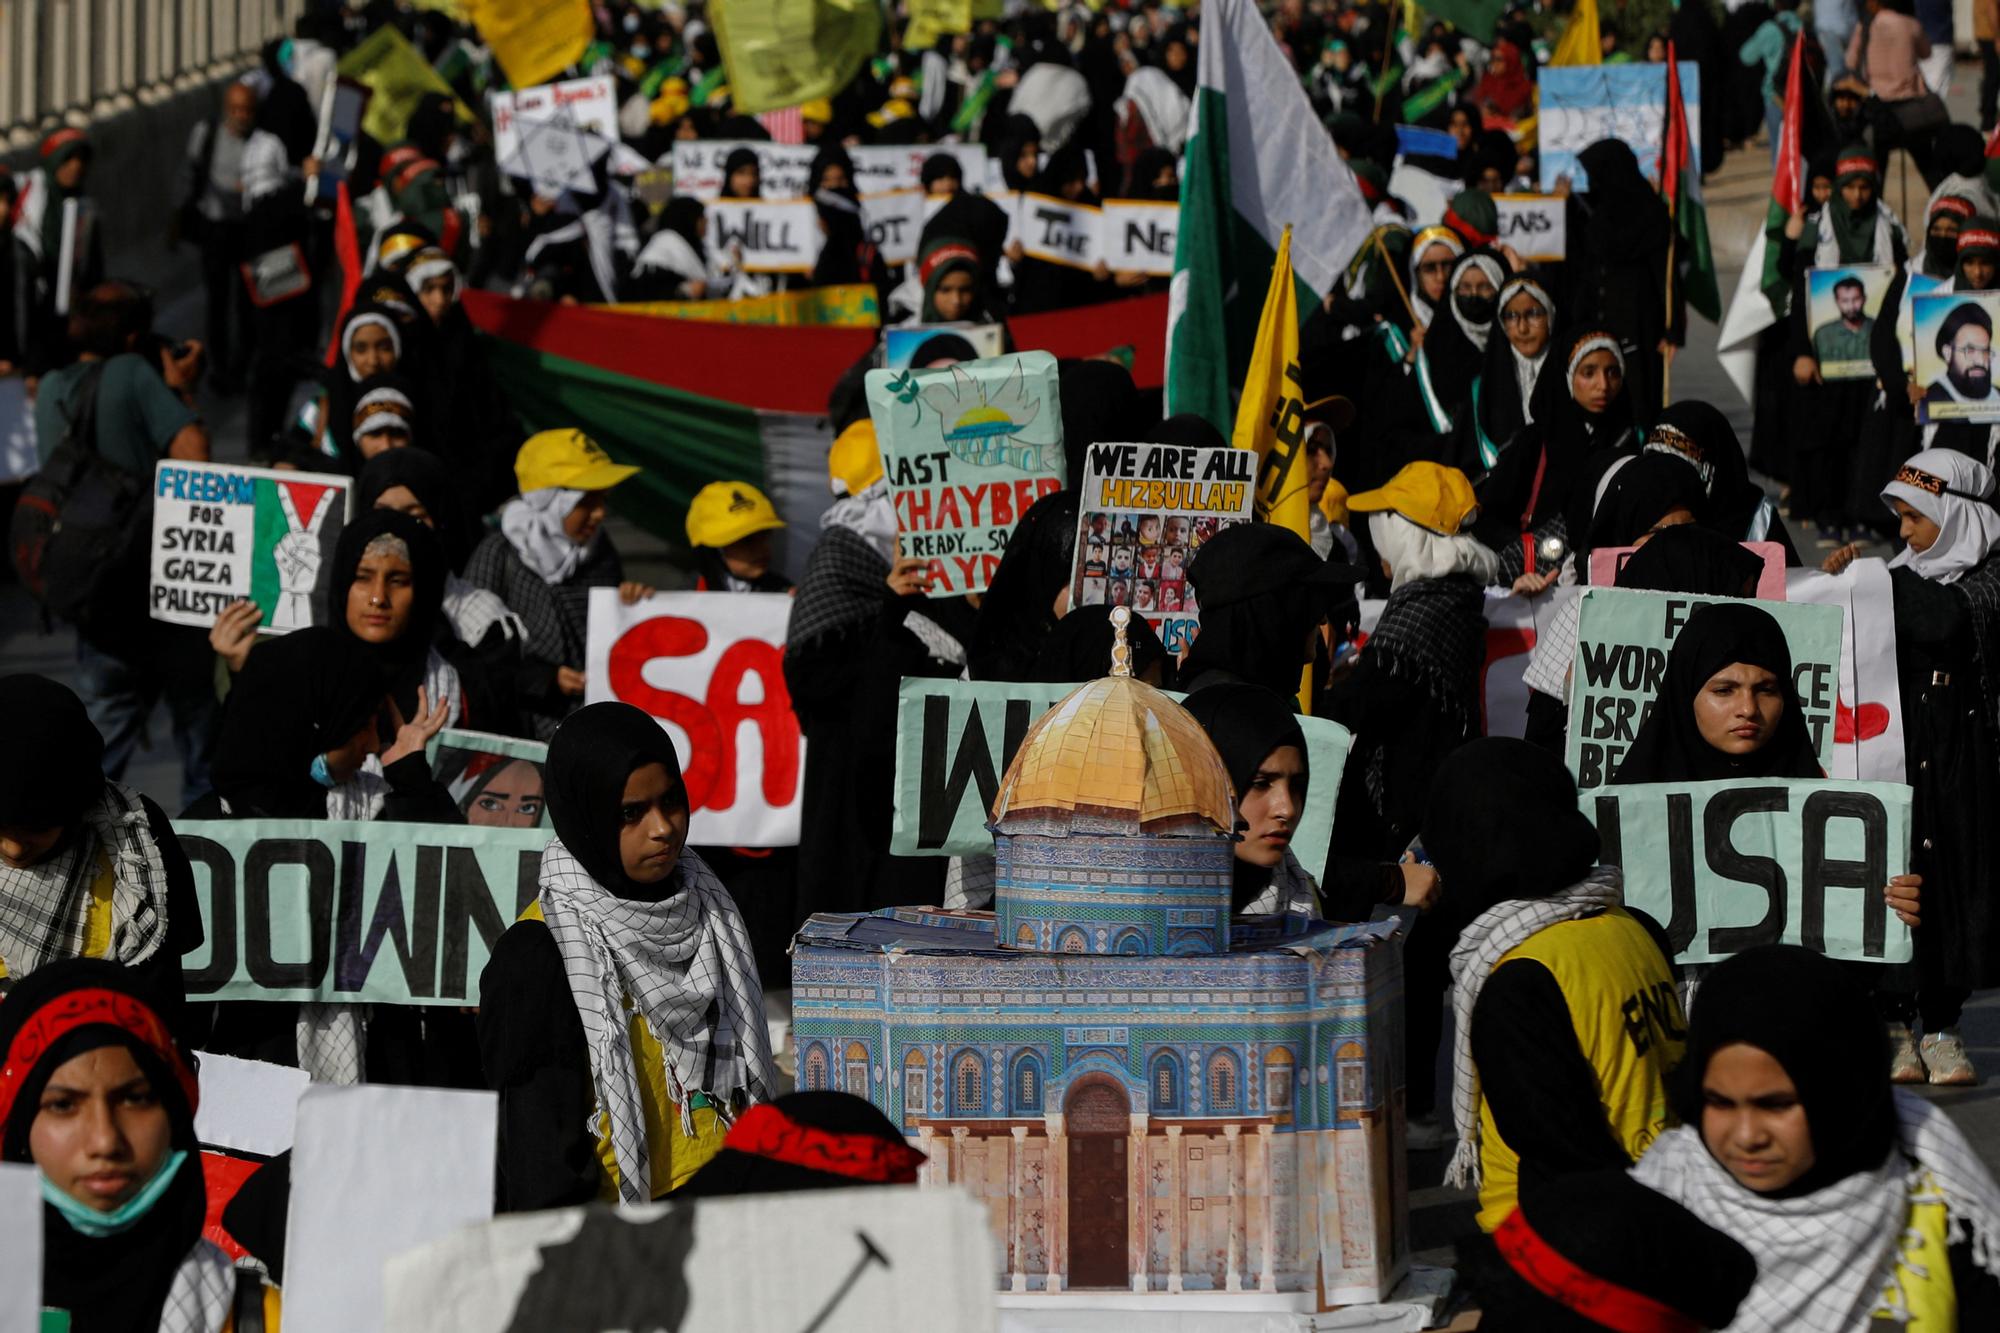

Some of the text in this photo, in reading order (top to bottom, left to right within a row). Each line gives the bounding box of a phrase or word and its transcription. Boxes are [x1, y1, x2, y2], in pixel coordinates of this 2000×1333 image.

[716, 209, 798, 251] WILL
[867, 217, 909, 245] OT
[1125, 220, 1175, 256] NE
[884, 451, 950, 486] LAST
[1091, 444, 1252, 482] WE ARE ALL
[158, 467, 255, 505] FREEDOM
[1100, 478, 1244, 512] HIZBULLAH
[189, 506, 225, 525] FOR
[161, 527, 235, 553] SYRIA
[913, 532, 983, 557] READY...
[988, 528, 1008, 550] SO
[164, 558, 232, 584] GAZA
[1580, 641, 1672, 693] WOR
[1581, 695, 1653, 742] ISR
[1595, 786, 1888, 958] USA
[176, 834, 545, 1000] DOWN
